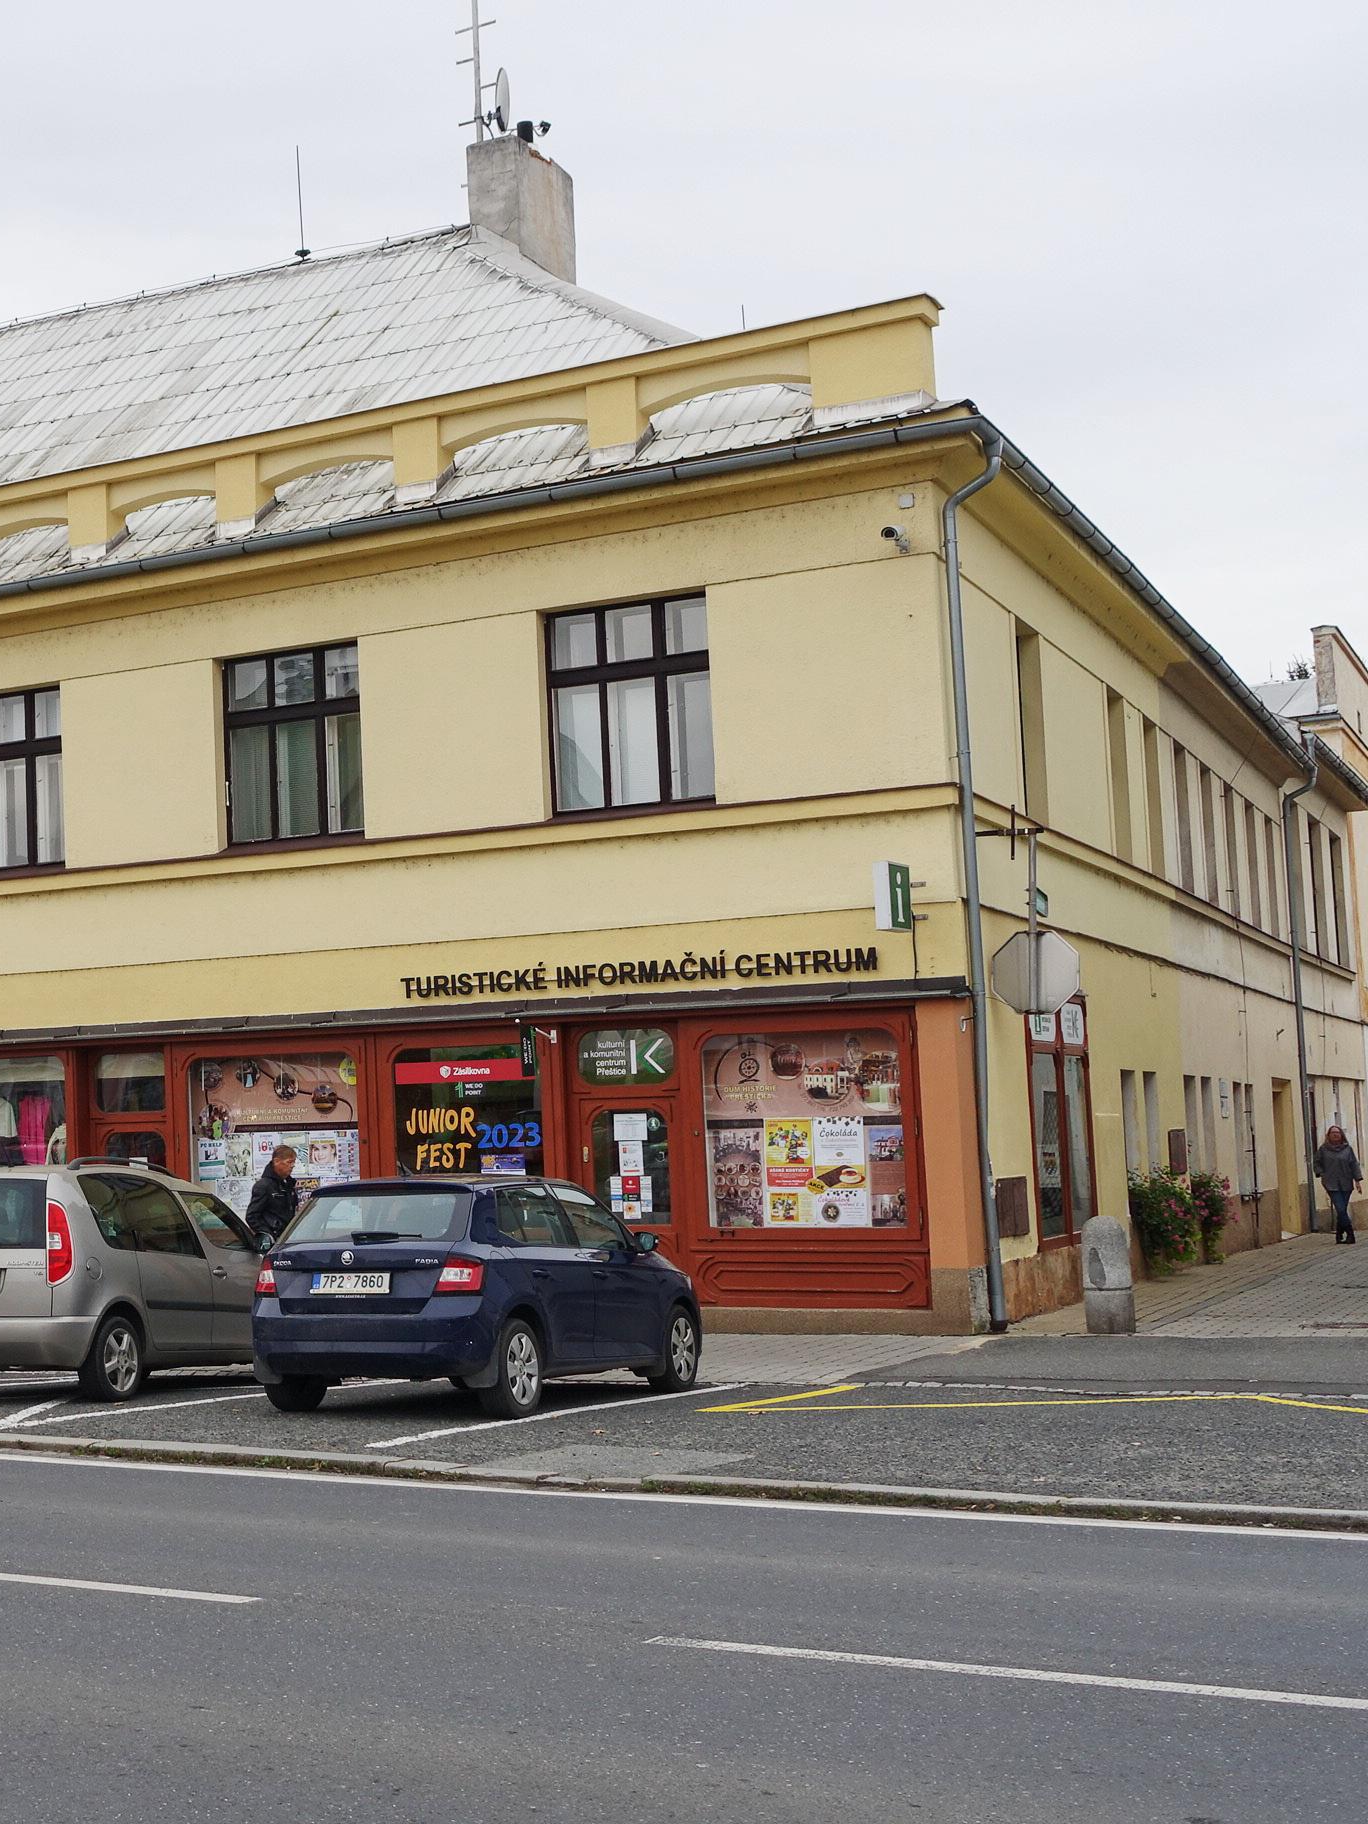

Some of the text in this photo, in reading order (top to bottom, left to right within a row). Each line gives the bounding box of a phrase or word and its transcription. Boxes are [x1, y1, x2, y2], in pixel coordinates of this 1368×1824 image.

[895, 871, 905, 923] i
[400, 946, 878, 999] TURISTICKÉ INFORMAČNÍ CENTRUM
[590, 1049, 626, 1058] komunitní
[596, 1059, 626, 1067] centrum
[453, 1067, 490, 1076] Zásilkovna
[596, 1067, 626, 1076] Přeštice
[406, 1107, 476, 1137] JUNIOR
[476, 1122, 541, 1149] 2023
[819, 1127, 858, 1137] Čokoláda
[416, 1142, 472, 1171] FEST
[323, 1275, 383, 1288] 7P2 7860
